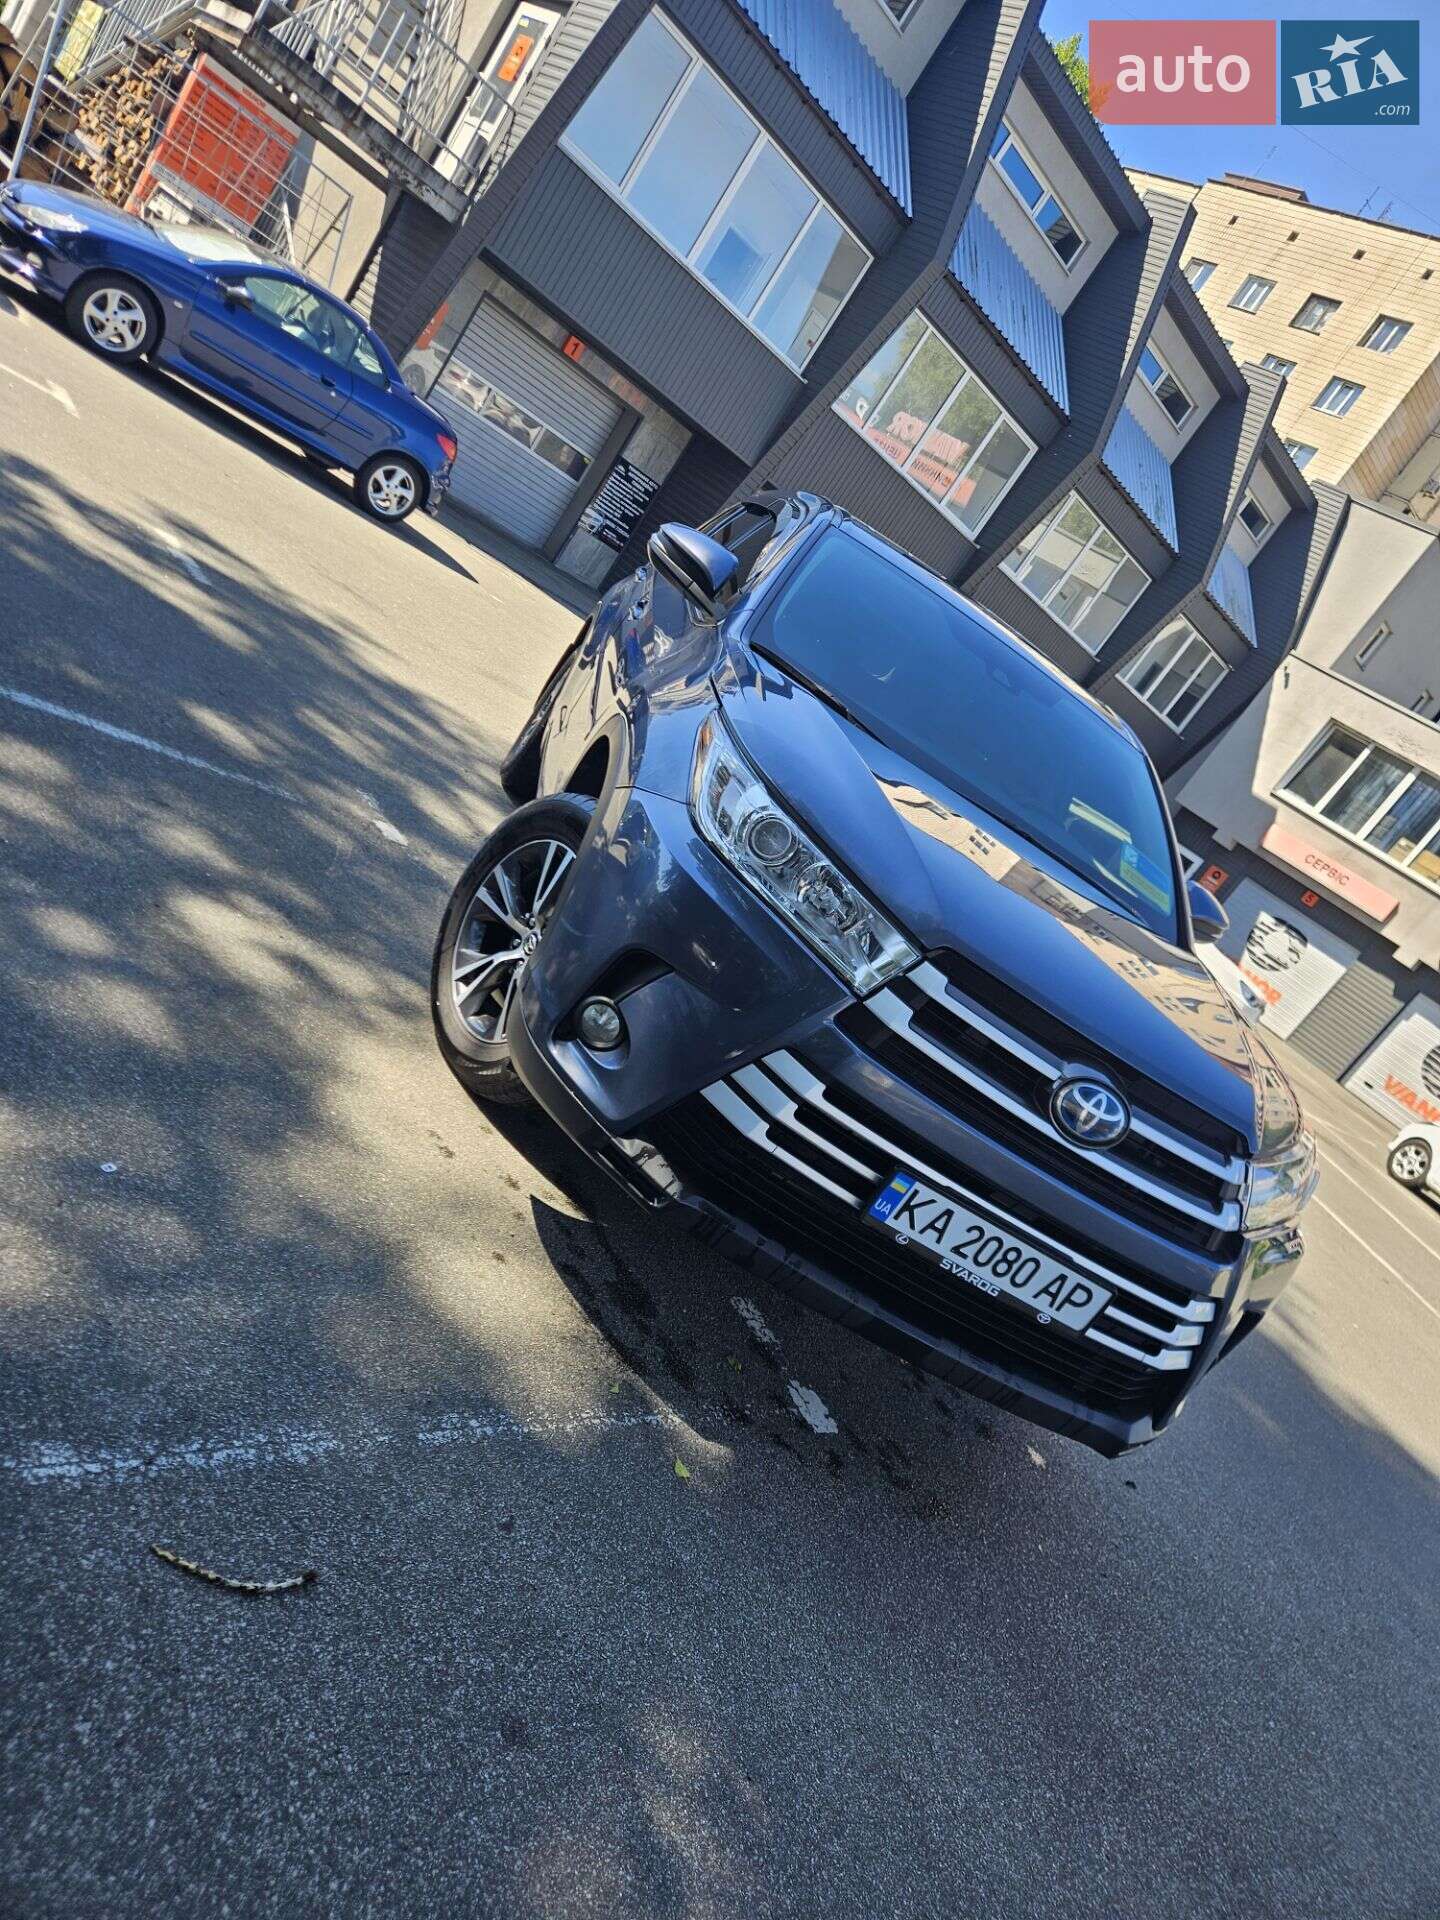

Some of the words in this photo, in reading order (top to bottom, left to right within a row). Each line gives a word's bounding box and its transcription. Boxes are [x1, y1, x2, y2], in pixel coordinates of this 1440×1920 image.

[1304, 854, 1350, 886] СЕРВІС
[874, 1199, 891, 1216] UA
[893, 1188, 956, 1245] KA
[950, 1225, 1041, 1289] 2080
[1032, 1273, 1094, 1312] AP
[940, 1257, 1001, 1297] SVAROG
